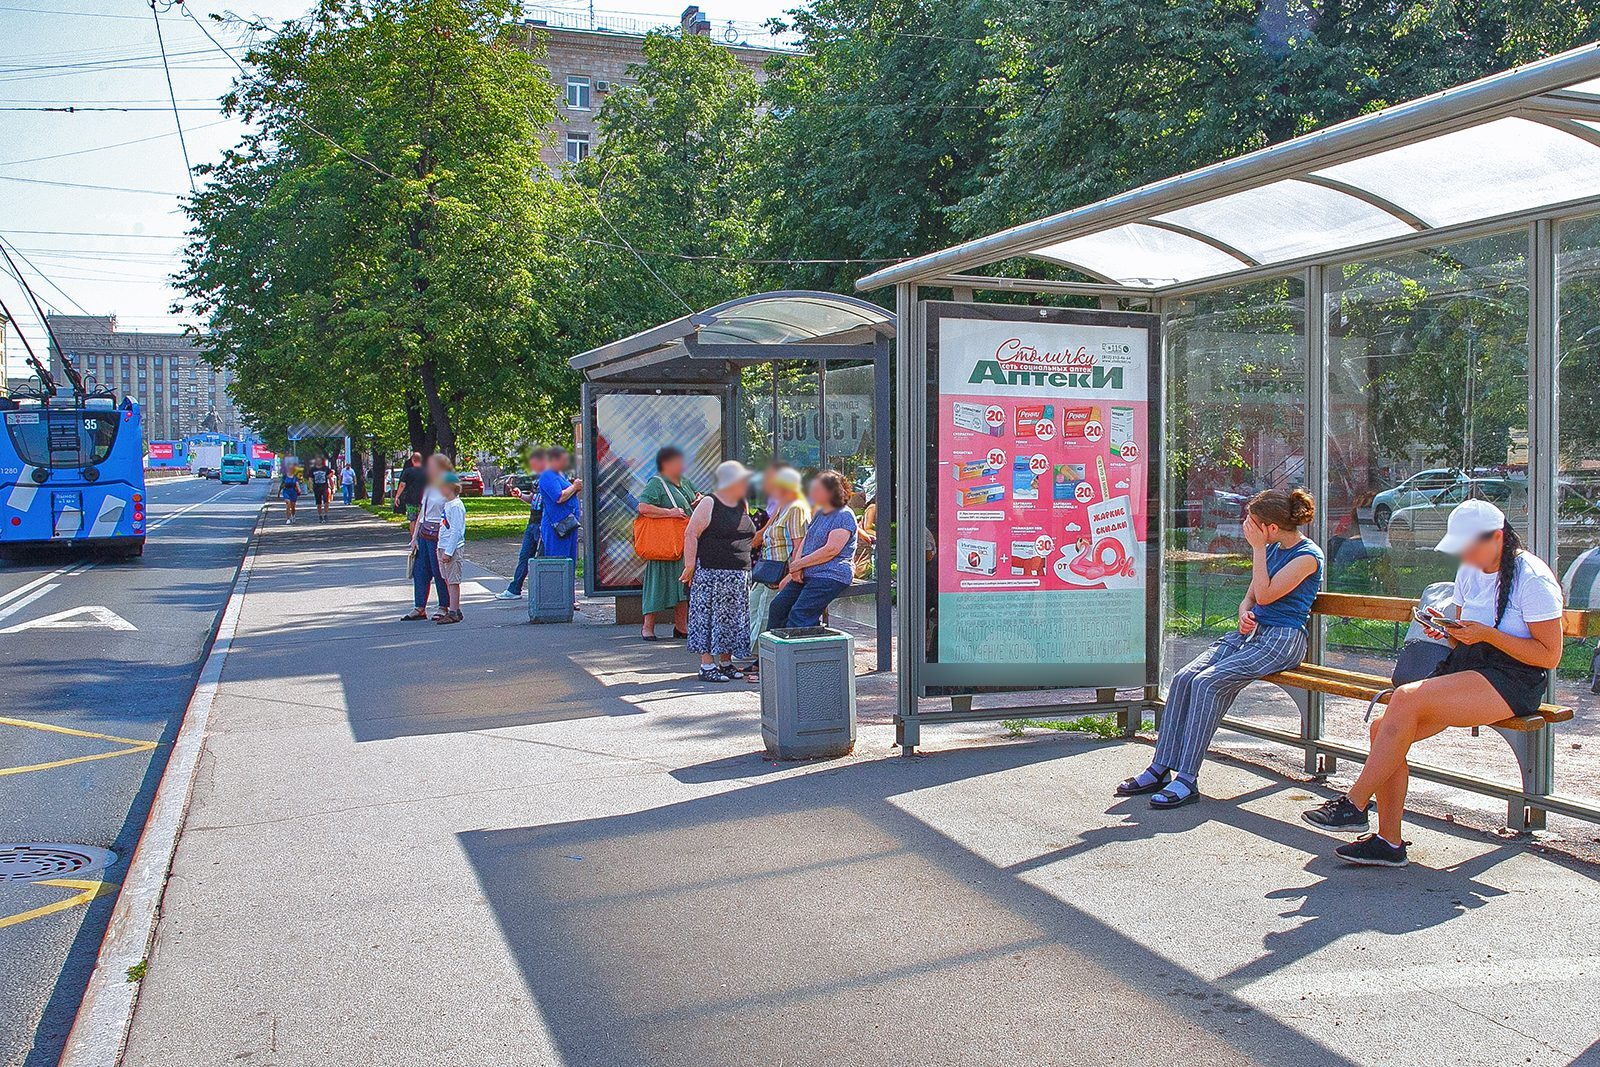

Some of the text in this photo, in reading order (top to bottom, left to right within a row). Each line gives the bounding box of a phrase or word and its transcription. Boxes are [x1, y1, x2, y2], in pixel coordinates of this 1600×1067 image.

[996, 338, 1098, 365] Столички
[1020, 365, 1068, 373] социальных
[1069, 366, 1092, 374] аптек
[84, 419, 97, 430] 35
[1093, 507, 1126, 522] ЖАРКИЕ
[1096, 521, 1127, 535] СКИДКИ
